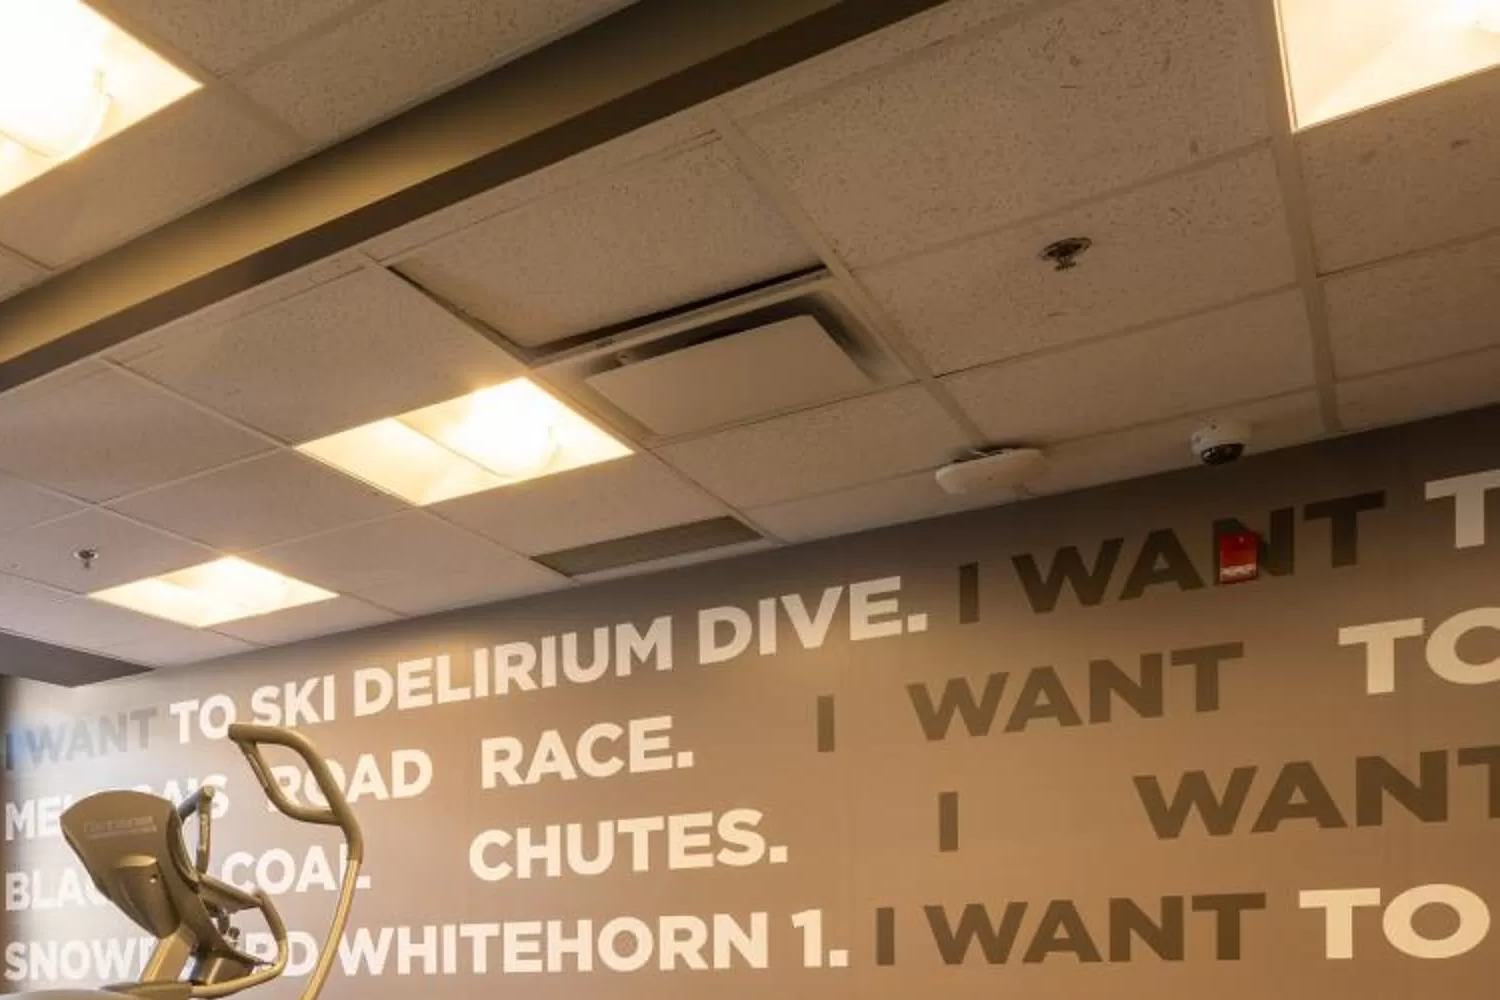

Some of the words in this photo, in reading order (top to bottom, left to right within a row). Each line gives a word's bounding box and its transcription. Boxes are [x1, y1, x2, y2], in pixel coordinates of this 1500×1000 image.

[26, 708, 157, 766] WANT
[169, 694, 237, 744] TO
[250, 674, 335, 731] SKI
[354, 614, 674, 717] DELIRIUM
[697, 575, 928, 664] DIVE.
[957, 561, 980, 625] I
[1011, 490, 1386, 615] WANT
[267, 748, 433, 812] ROAD
[481, 715, 694, 790] RACE.
[816, 694, 836, 753] I
[905, 641, 1245, 742] WANT
[1337, 606, 1500, 695] TO
[468, 808, 788, 882] CHUTES.
[937, 791, 959, 853] I
[342, 913, 769, 976] WHITEHORN
[791, 909, 849, 970] 1.
[875, 906, 896, 967] I
[924, 891, 1266, 966] WANT
[1299, 883, 1491, 961] TO
